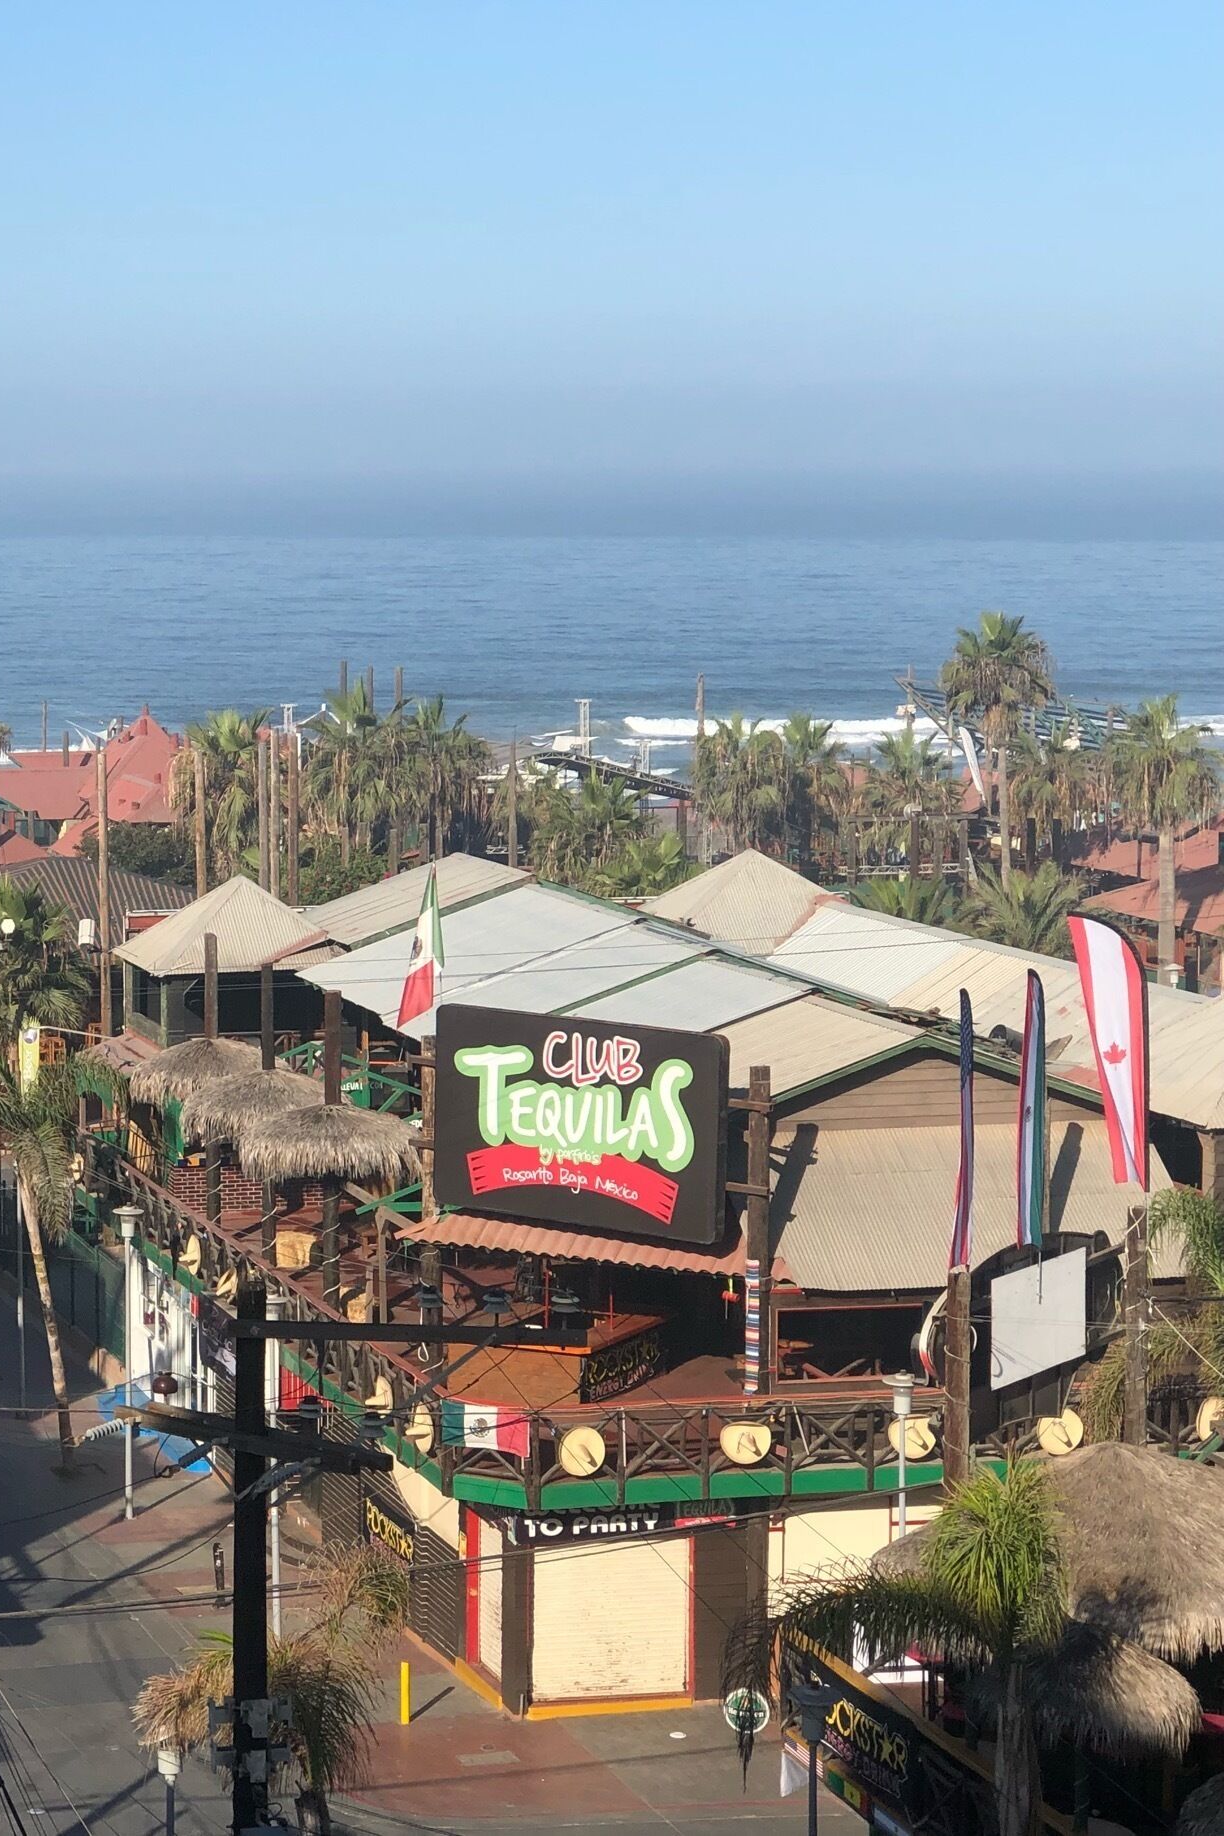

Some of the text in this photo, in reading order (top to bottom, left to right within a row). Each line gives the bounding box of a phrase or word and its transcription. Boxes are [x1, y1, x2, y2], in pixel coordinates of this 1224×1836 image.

[543, 1031, 643, 1087] CLUB
[456, 1047, 692, 1168] TEQUILAS
[502, 1166, 553, 1185] Rosarito
[559, 1167, 588, 1194] Baja
[524, 1518, 564, 1538] TO
[572, 1512, 659, 1535] PARTY
